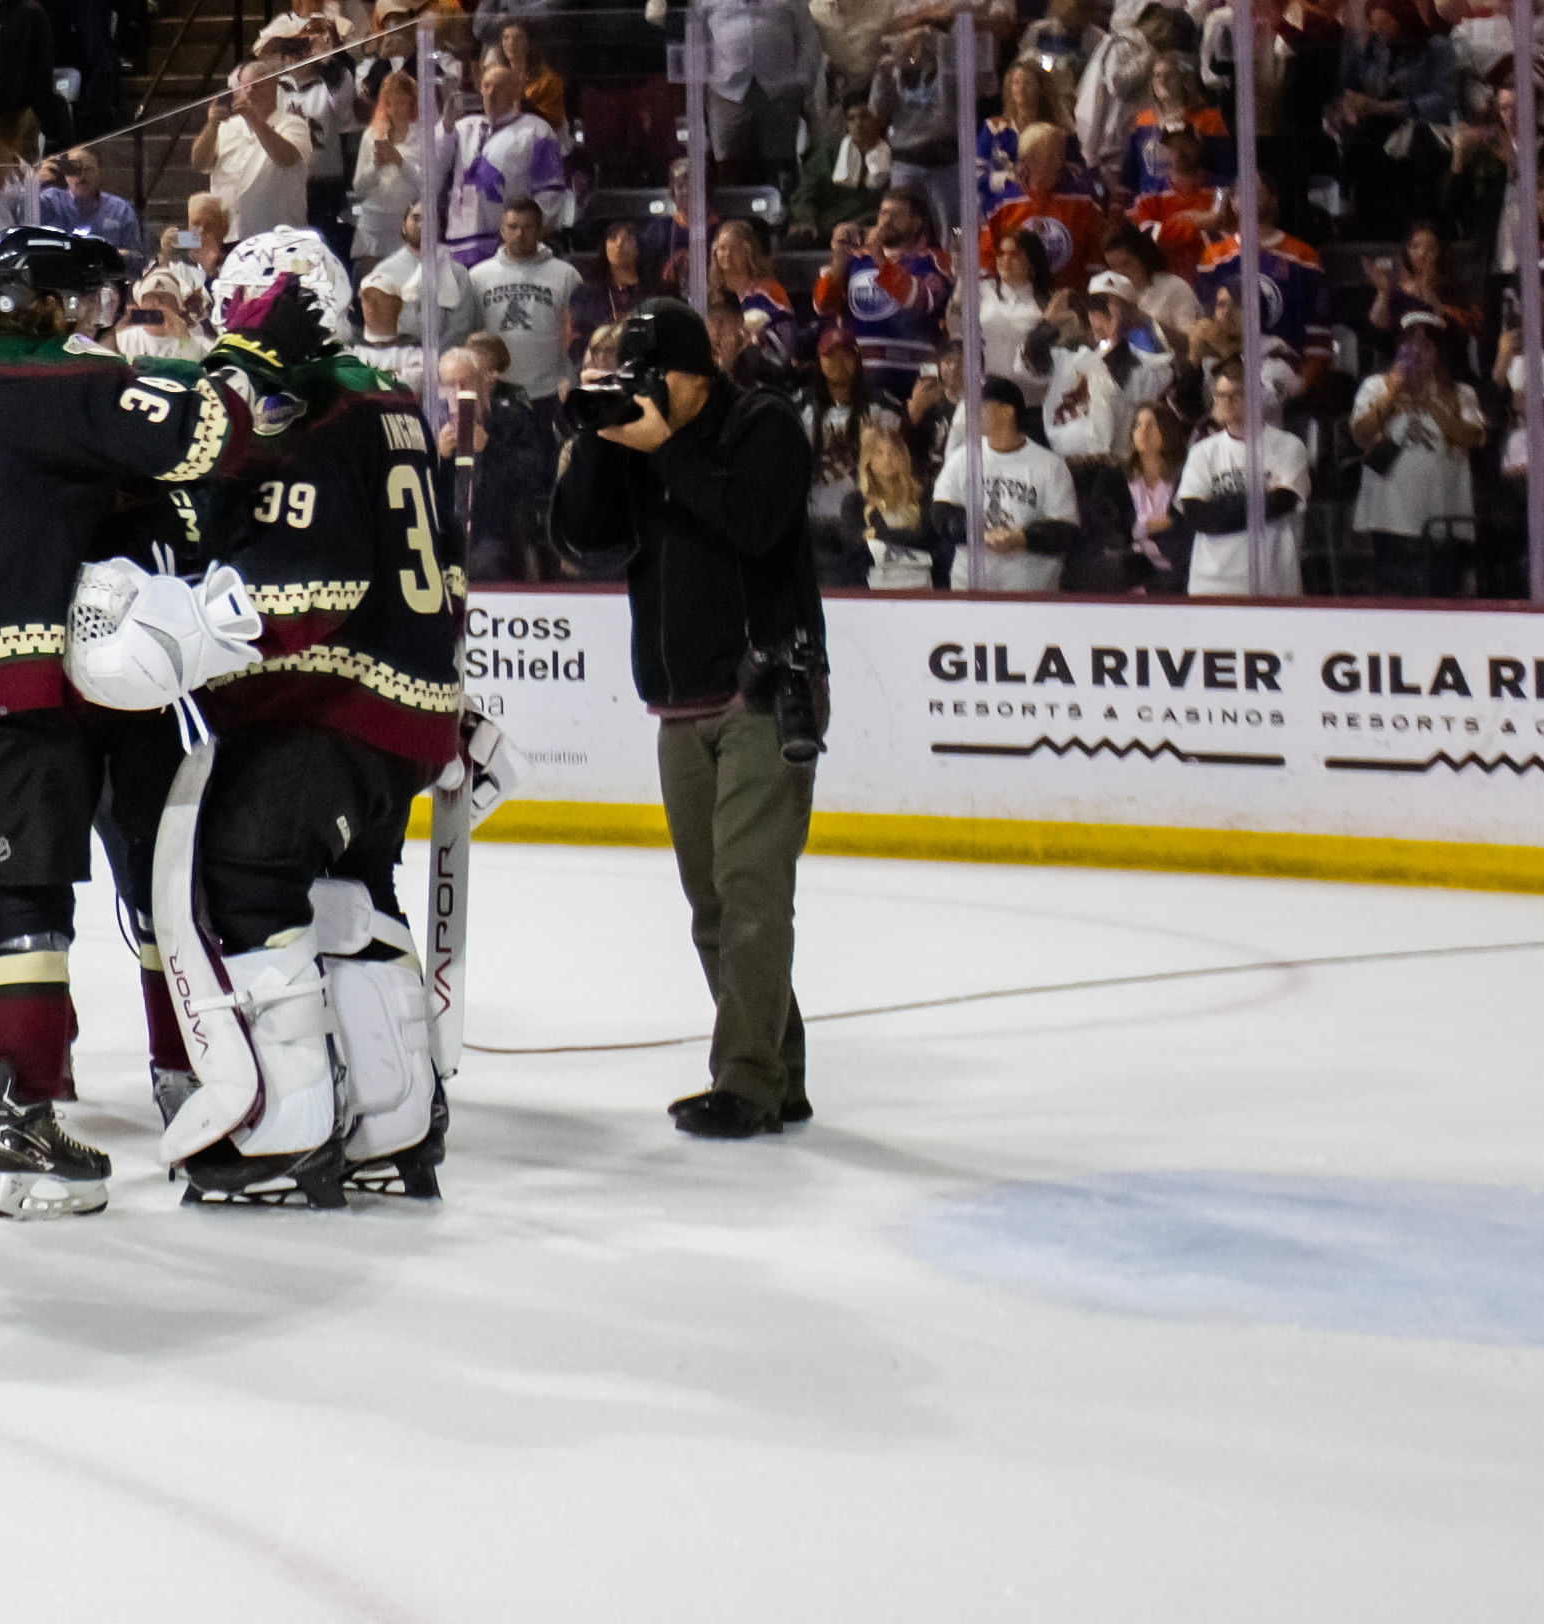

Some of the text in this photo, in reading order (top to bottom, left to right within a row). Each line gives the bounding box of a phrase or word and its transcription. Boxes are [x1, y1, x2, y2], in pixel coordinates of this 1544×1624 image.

[253, 480, 317, 529] 39
[465, 607, 572, 640] Cross
[465, 648, 586, 681] Shield
[928, 643, 1283, 693] GILA RIVER
[1320, 652, 1474, 699] GILA
[929, 699, 1083, 721] RESORTS
[1137, 705, 1286, 728] CASINOS
[1322, 711, 1480, 735] RESORTS
[434, 837, 459, 1020] VAPOR
[169, 947, 209, 1060] VAPOR
